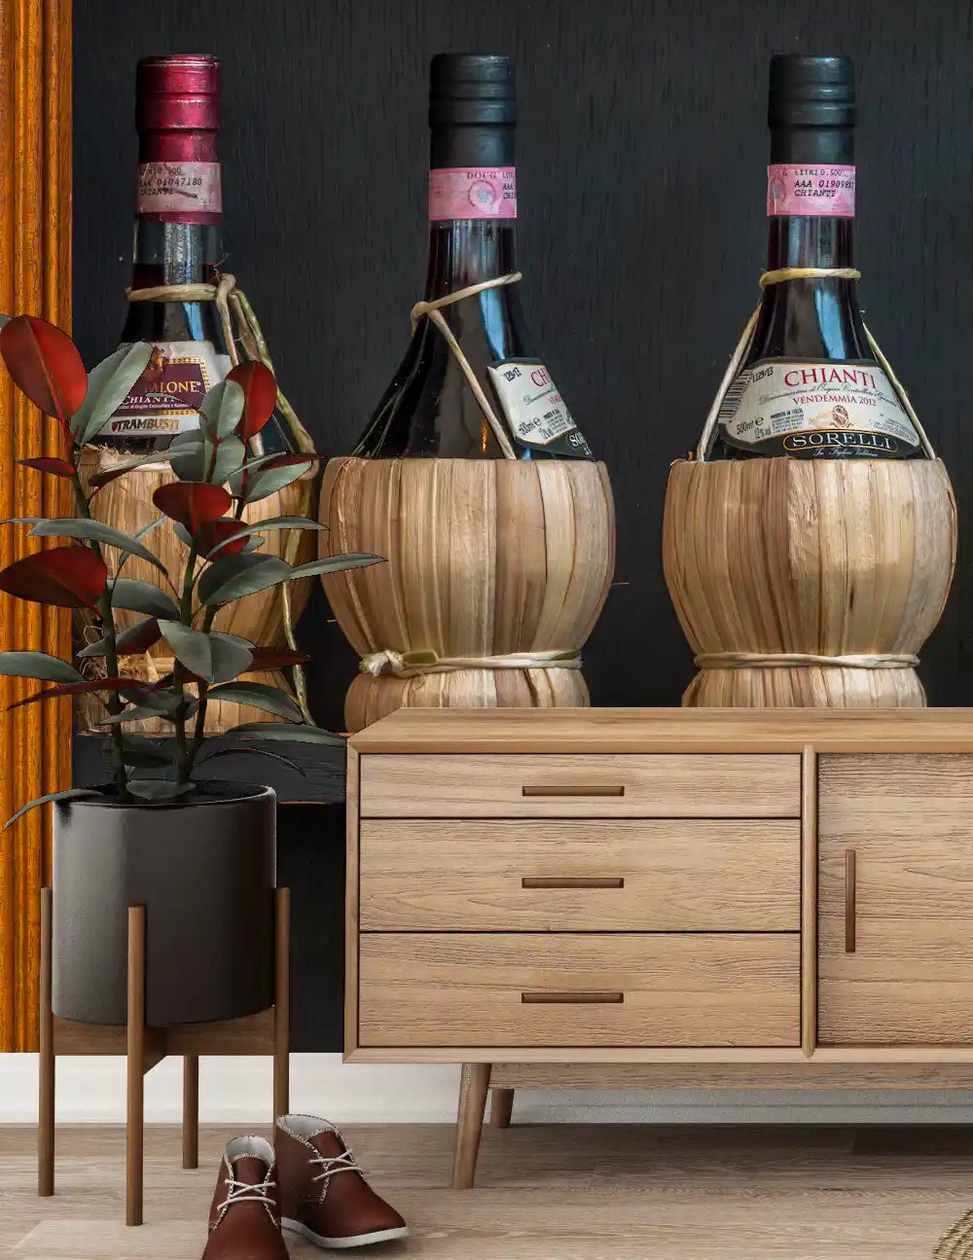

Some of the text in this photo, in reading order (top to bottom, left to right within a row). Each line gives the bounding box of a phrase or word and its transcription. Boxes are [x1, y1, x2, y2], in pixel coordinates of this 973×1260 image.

[794, 180, 813, 188] AAA
[794, 189, 837, 198] CHIANTI
[784, 368, 876, 389] CHIANTI
[793, 395, 857, 405] VENDEMMIA
[859, 396, 877, 406] 2012
[117, 418, 179, 431] TRAMBUSTI
[792, 432, 891, 449] SORELLI
